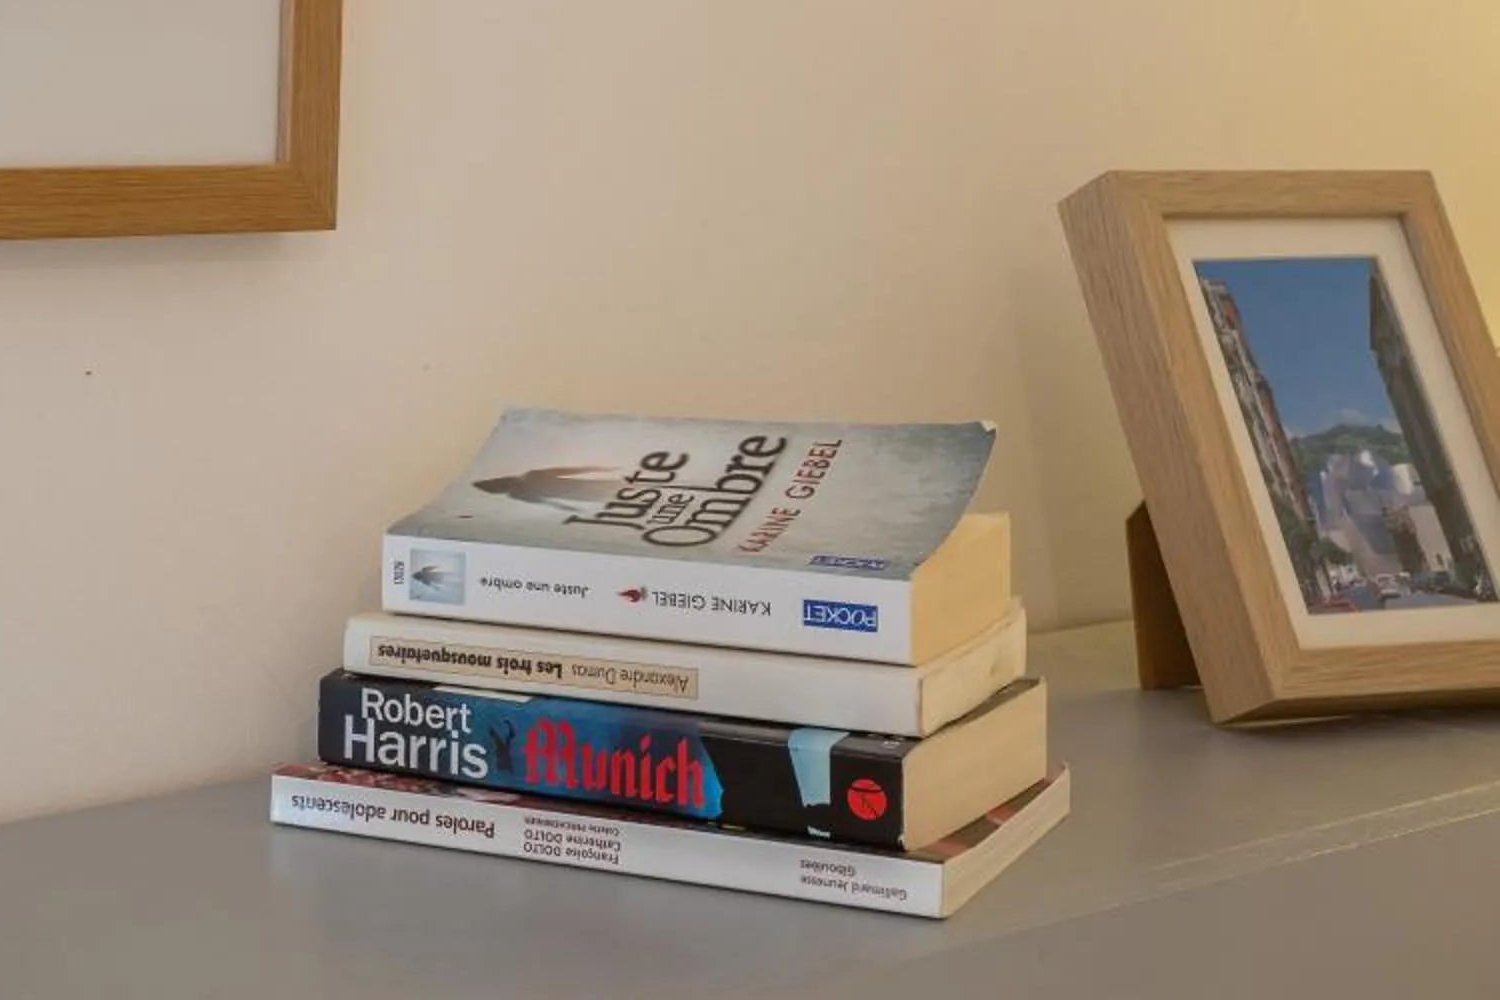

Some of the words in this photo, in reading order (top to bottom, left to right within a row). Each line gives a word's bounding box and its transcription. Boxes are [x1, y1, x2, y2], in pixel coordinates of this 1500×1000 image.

[562, 450, 690, 530] Juste
[641, 434, 788, 547] Ombre
[736, 506, 802, 554] KARINE
[783, 438, 843, 501] GIEBEL
[646, 492, 695, 525] une
[479, 575, 522, 592] ombre
[525, 581, 550, 592] une
[553, 582, 590, 600] Juste
[651, 590, 706, 611] GIEBEL
[711, 594, 773, 617] KARINE
[803, 603, 878, 627] POCKET
[377, 643, 492, 670] mousquetaires
[496, 656, 533, 674] trois
[535, 662, 563, 680] Les
[570, 664, 618, 685] Dumas
[619, 667, 690, 694] Alexandre
[360, 686, 473, 735] Robert
[343, 713, 490, 781] Harris
[523, 718, 705, 808] Munich
[291, 794, 387, 823] adolescents
[389, 806, 431, 826] pour
[435, 814, 496, 839] Paroles
[523, 828, 563, 844] DOLTO
[523, 841, 561, 857] DOLTO
[565, 835, 621, 853] Catherine
